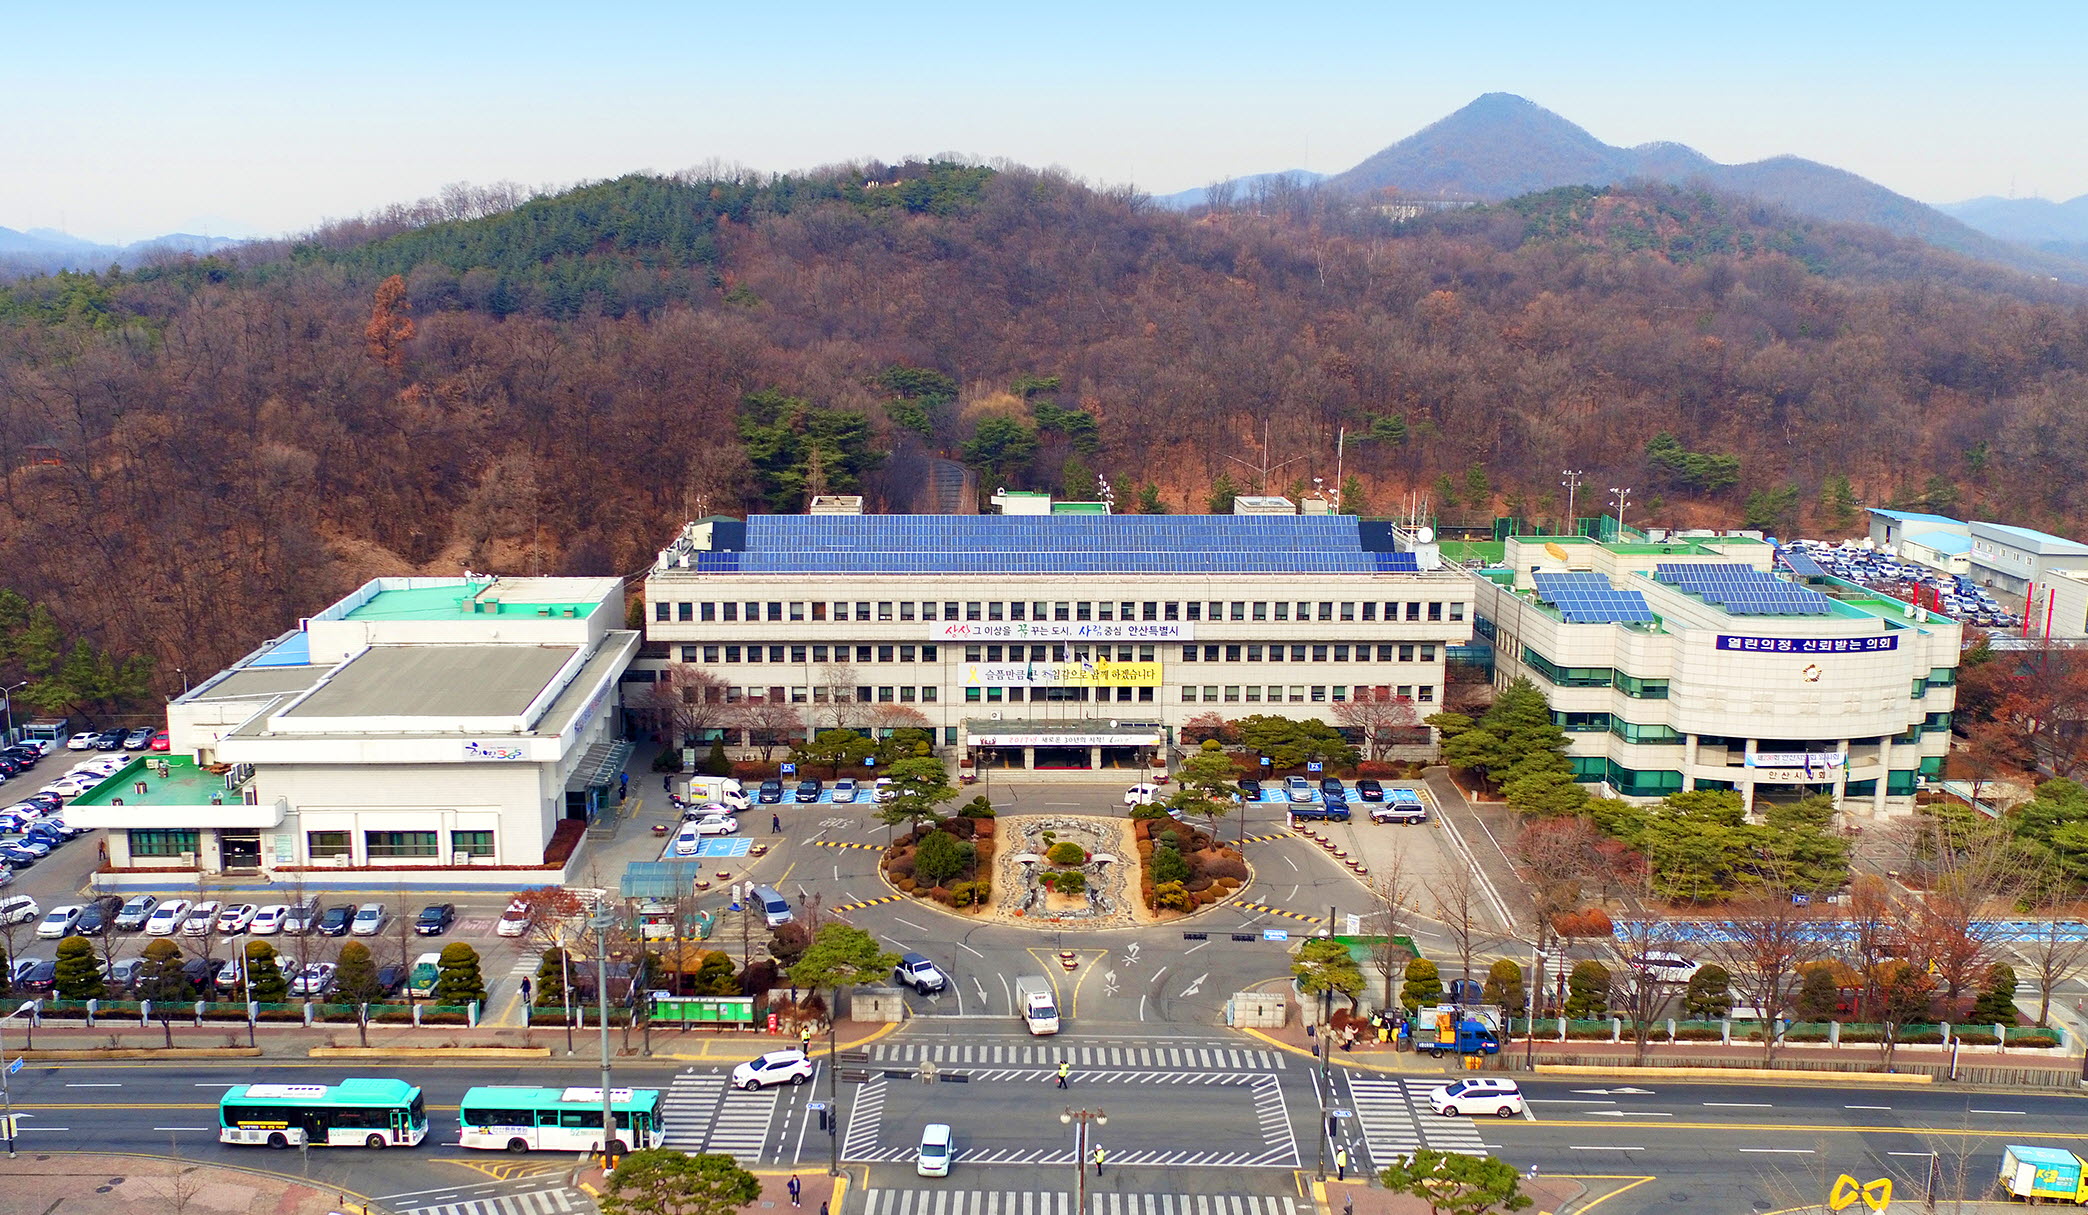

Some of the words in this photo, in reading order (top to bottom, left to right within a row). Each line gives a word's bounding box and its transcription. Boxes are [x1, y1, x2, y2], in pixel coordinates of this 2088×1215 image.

[973, 626, 982, 635] 그
[984, 626, 1012, 636] 이상을
[1128, 625, 1179, 637] 안산특별시
[1727, 637, 1797, 651] 열린의정,
[1802, 640, 1862, 651] 신뢰받는
[1866, 638, 1891, 649] 의회
[985, 669, 1026, 681] 슬픔만큼
[1042, 668, 1088, 681] 임감으로
[1111, 668, 1156, 681] 하겠습니다
